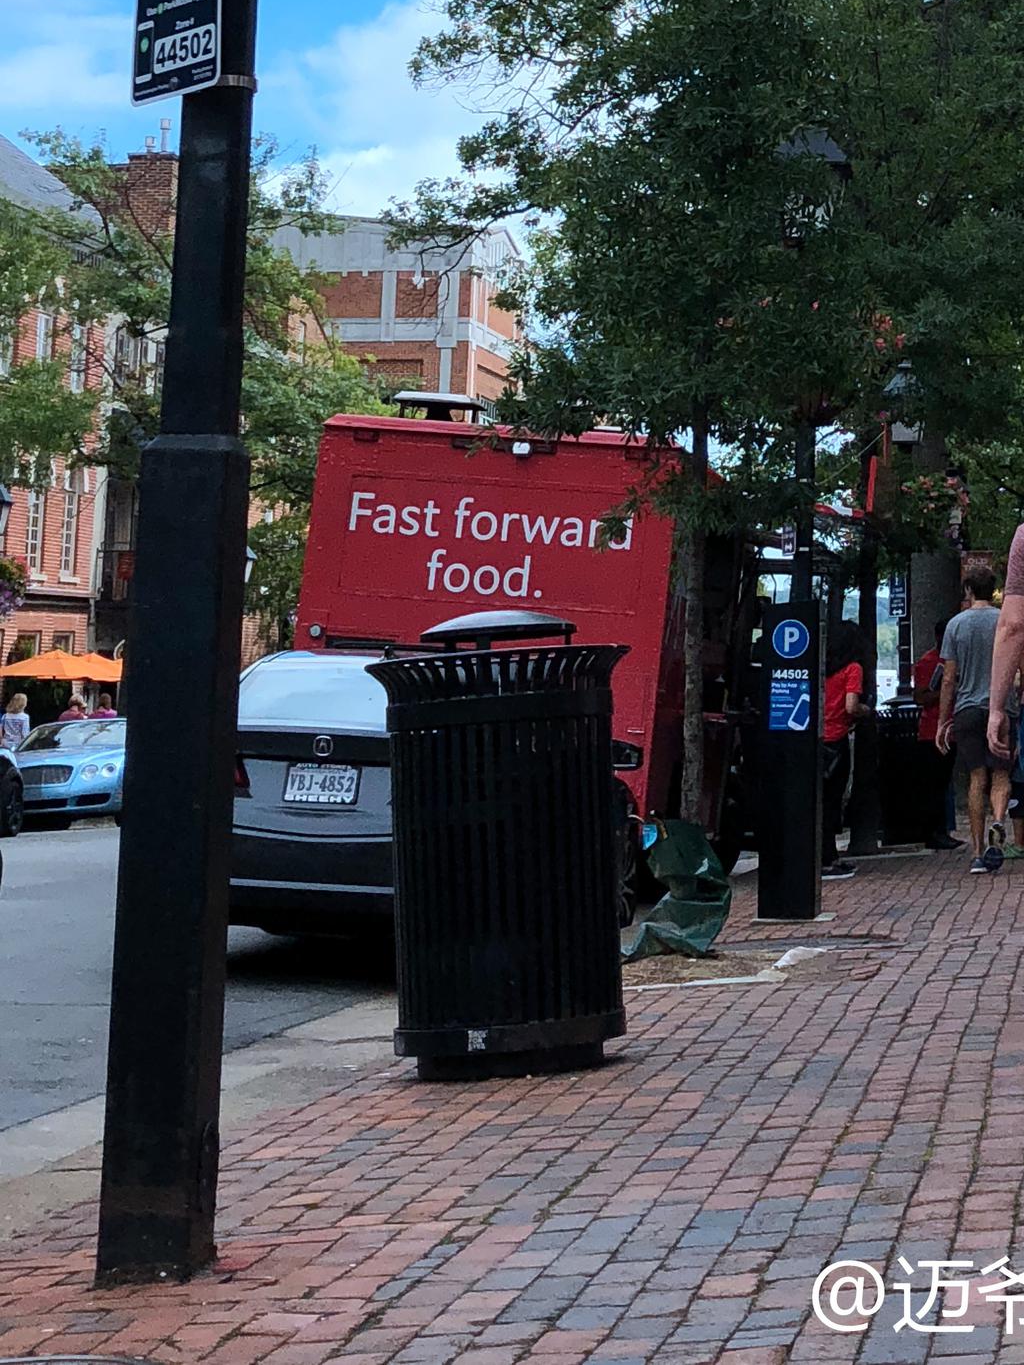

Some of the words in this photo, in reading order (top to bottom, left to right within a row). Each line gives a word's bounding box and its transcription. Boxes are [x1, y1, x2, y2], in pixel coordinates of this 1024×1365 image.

[156, 28, 213, 68] 44502
[349, 491, 440, 537] Fast
[455, 497, 634, 551] forward
[427, 549, 542, 599] food.
[967, 557, 988, 565] OLD
[784, 626, 800, 652] P
[290, 774, 355, 793] VBJ-4852
[284, 794, 354, 803] SHEEHY
